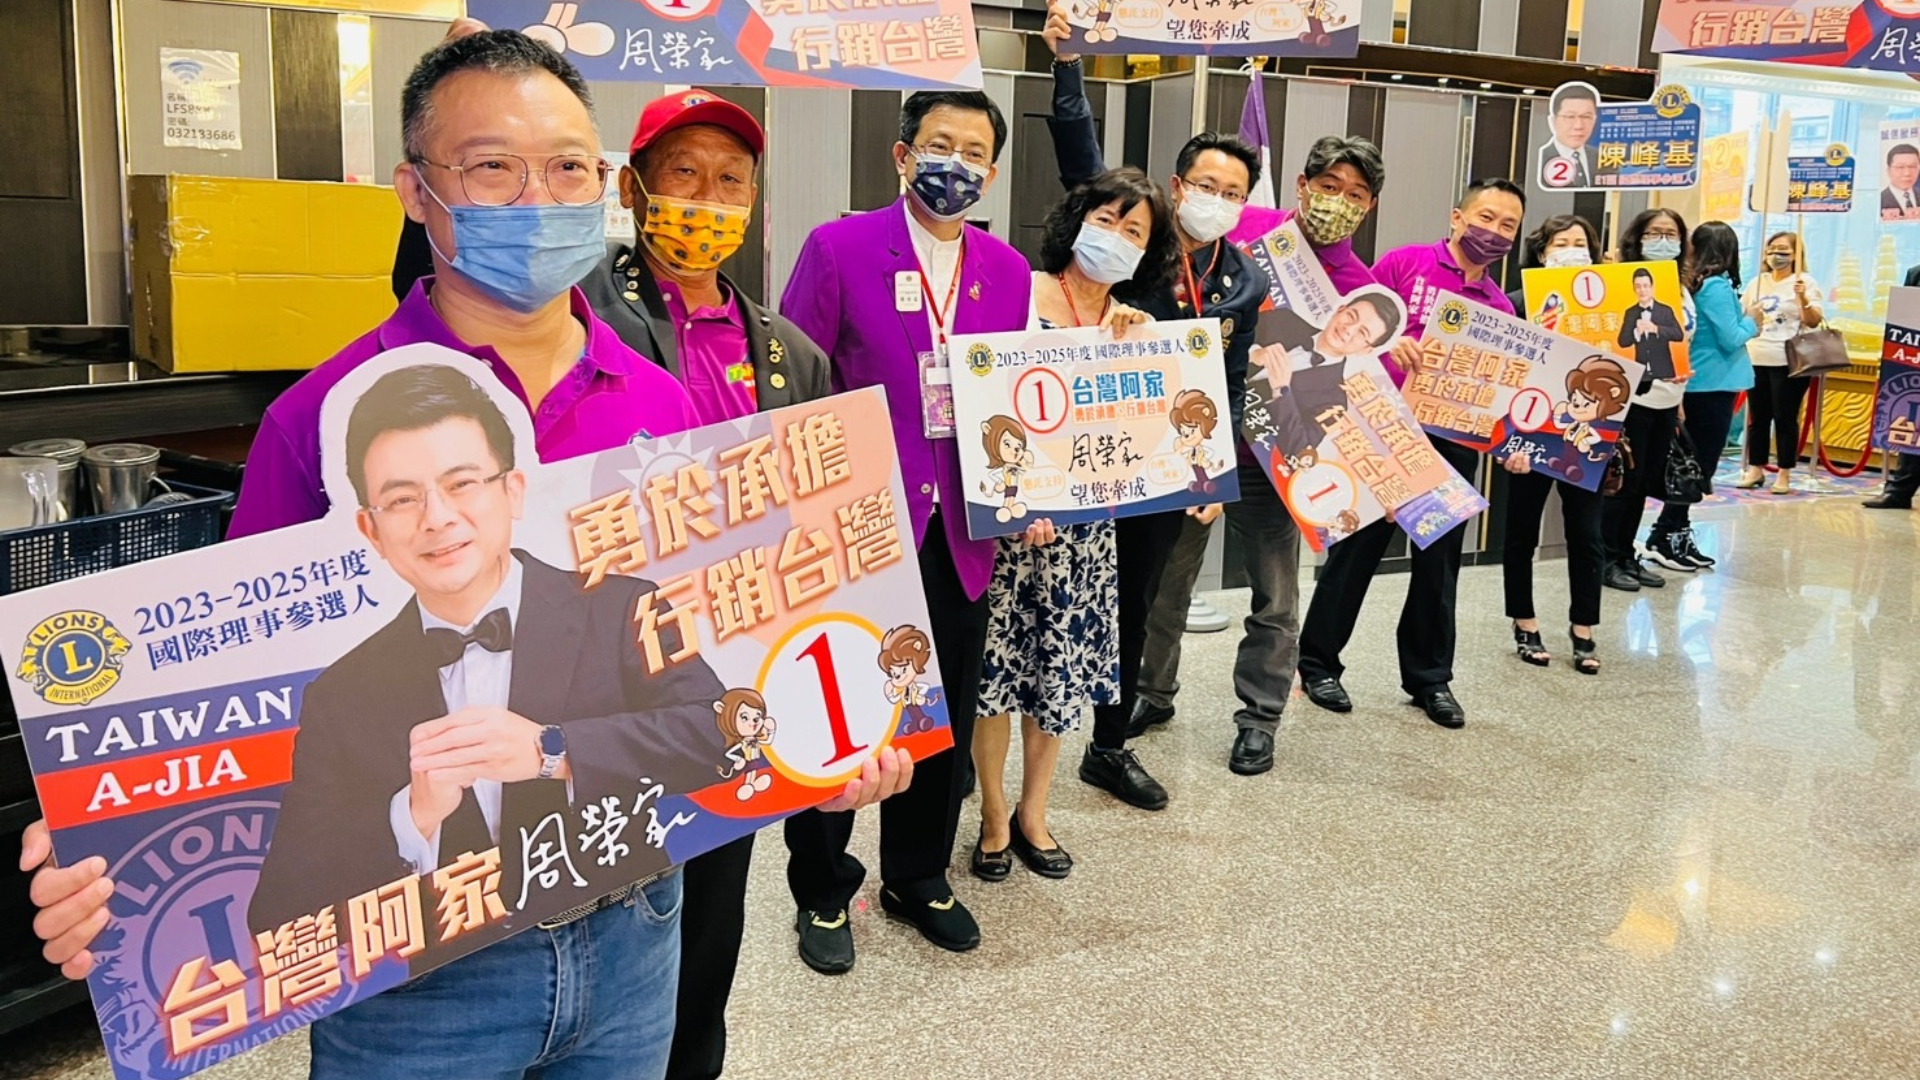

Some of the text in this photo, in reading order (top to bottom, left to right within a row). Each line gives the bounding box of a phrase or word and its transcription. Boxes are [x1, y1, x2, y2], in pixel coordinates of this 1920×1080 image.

[791, 15, 965, 71] 行銷台灣
[1166, 19, 1250, 41] 望您牽成
[1691, 7, 1850, 47] 行銷台灣
[619, 28, 734, 73] 周榮家
[1553, 163, 1568, 181] 2
[1597, 139, 1695, 169] 陳峰基
[1716, 143, 1725, 165] 2
[1584, 276, 1592, 301] 1
[1466, 324, 1547, 365] 國際理事參選人
[1471, 311, 1555, 351] 2023-2025年度
[996, 347, 1092, 367] 2023-2025年度
[1095, 338, 1185, 360] 國際理事參選人
[1422, 338, 1533, 388] 台灣阿家
[1032, 380, 1050, 422] 1
[1072, 370, 1165, 405] 台灣阿家
[1410, 371, 1497, 409] 勇於承擔
[1339, 371, 1435, 476] 勇於承擔
[1414, 401, 1498, 438] 行銷台灣
[1524, 396, 1538, 424] 1
[1069, 431, 1144, 473] 周榮家
[1315, 405, 1412, 509] 行銷台灣
[569, 412, 853, 589] 勇於承擔
[1070, 476, 1147, 507] 望您牽成
[1308, 481, 1338, 504] 1
[134, 549, 371, 634] 2023-2025年度
[633, 487, 904, 675] 行銷台灣
[33, 614, 99, 641] LIONS
[146, 584, 379, 671] 國際理事參選人
[58, 640, 94, 675] L
[49, 674, 114, 700] INTERNATIONAL
[795, 632, 869, 768] 1
[45, 686, 293, 763] TAIWAN
[86, 749, 247, 812] A-JIA
[515, 777, 697, 910] 周榮家
[162, 846, 507, 1056] 台灣阿家
